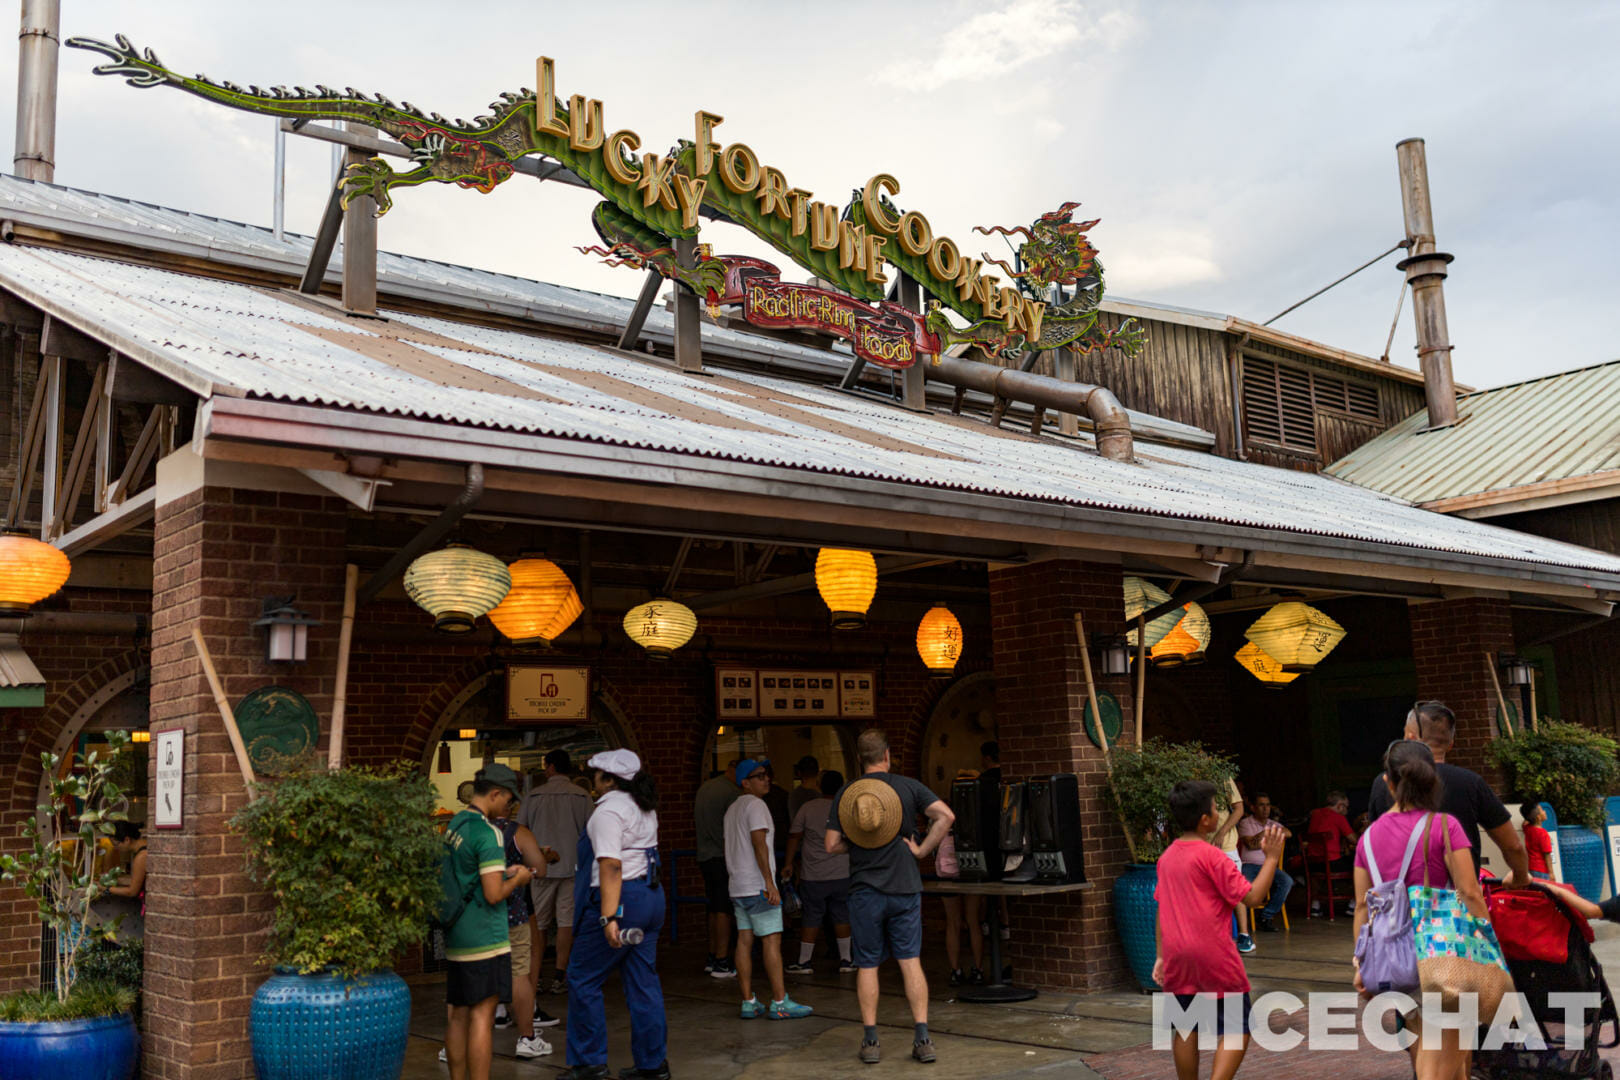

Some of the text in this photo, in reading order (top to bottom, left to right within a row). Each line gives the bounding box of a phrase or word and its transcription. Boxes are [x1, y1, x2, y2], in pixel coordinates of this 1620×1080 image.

[536, 55, 1047, 342] LUCKY FORTUNE COOKERY
[753, 286, 856, 333] Pacific Rim
[862, 324, 913, 362] Foods
